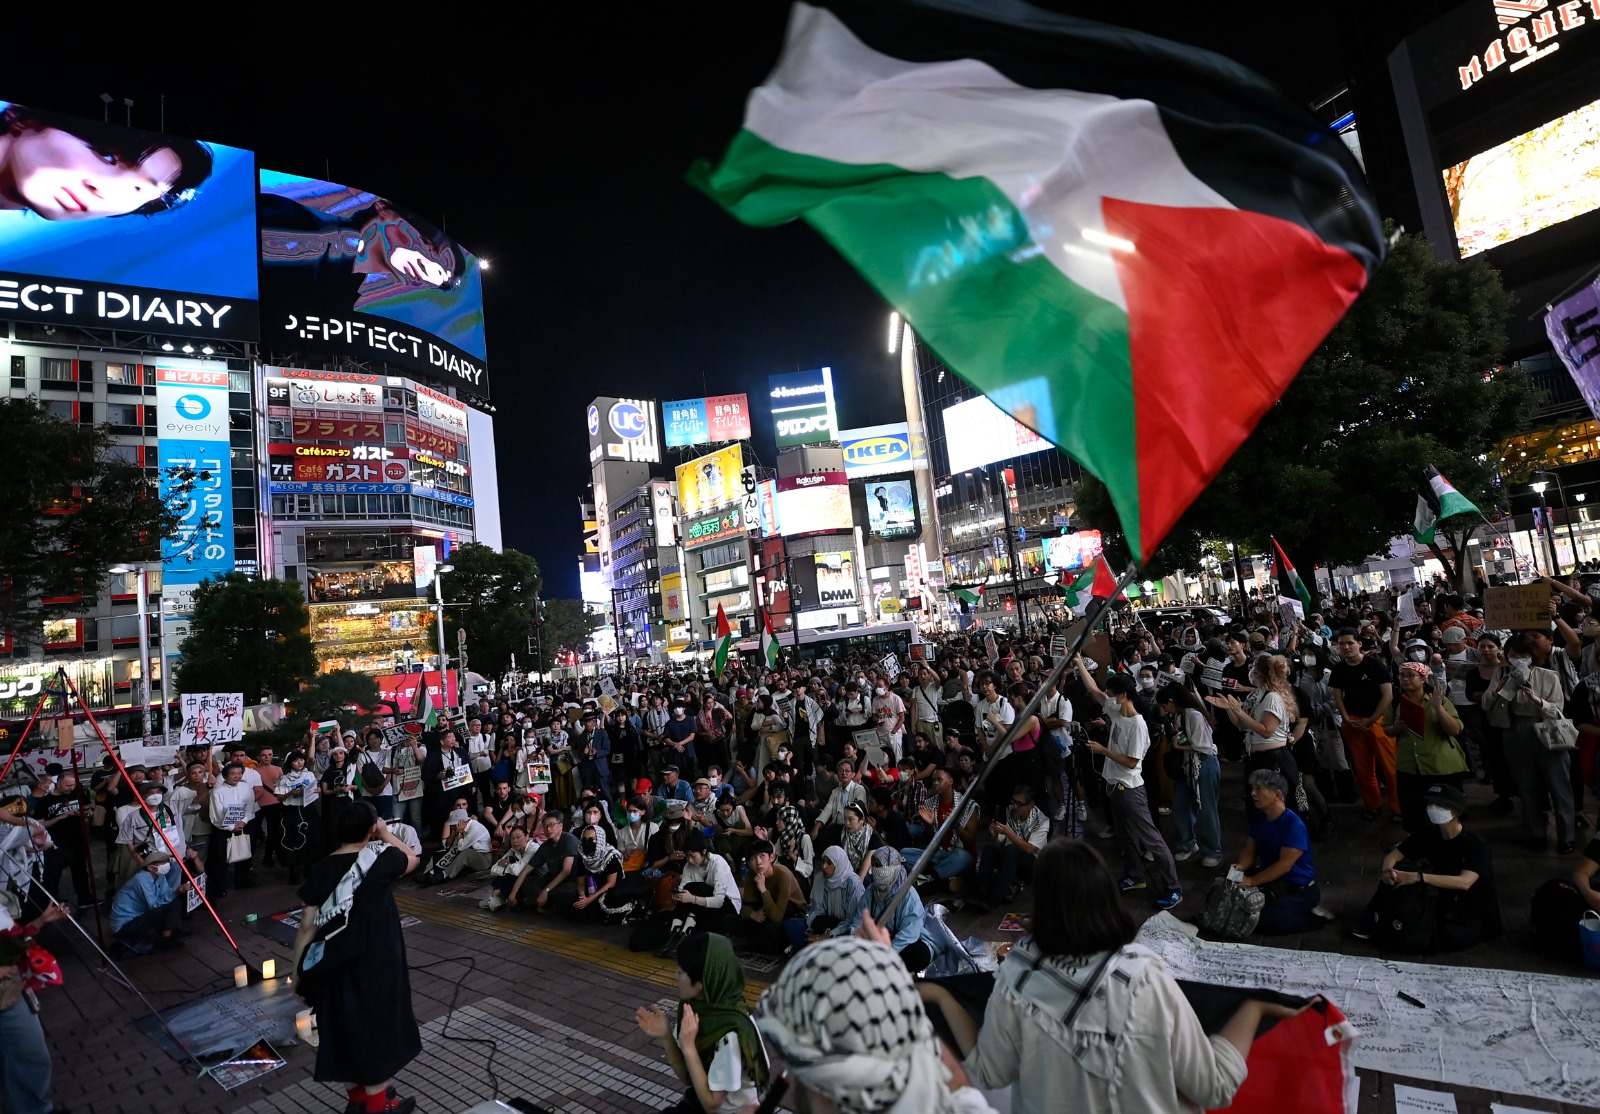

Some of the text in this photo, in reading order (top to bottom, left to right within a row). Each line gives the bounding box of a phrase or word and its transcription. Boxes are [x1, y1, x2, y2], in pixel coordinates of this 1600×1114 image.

[98, 290, 231, 329] DIARY
[428, 343, 483, 386] DIARY
[164, 370, 221, 384] 当ビル5F
[282, 368, 379, 384] しゃぶしゃぶバイキング
[269, 387, 288, 398] 9F
[323, 389, 377, 405] しゃぶ葉
[612, 410, 645, 431] UC
[166, 423, 221, 435] eyecity
[294, 421, 381, 437] プライス
[406, 427, 455, 453] コンタクト
[352, 446, 394, 460] ガスト
[847, 442, 904, 459] IKEA
[271, 464, 293, 475] 7F
[298, 464, 323, 473] Café
[326, 462, 378, 480] ガスト
[445, 460, 467, 477] ガスト
[311, 482, 389, 492] 英会話イーオン
[796, 475, 826, 486] Rakuten
[433, 490, 474, 506] 英会話イーオン
[741, 468, 760, 527] もんじゃ
[202, 459, 226, 560] コンタクトの
[820, 588, 854, 602] DMM
[1510, 601, 1523, 609] WE
[1512, 611, 1537, 622] FREE
[186, 694, 241, 713] 中東に刺さった
[218, 706, 237, 714] THORN
[192, 727, 240, 745] イスラエル
